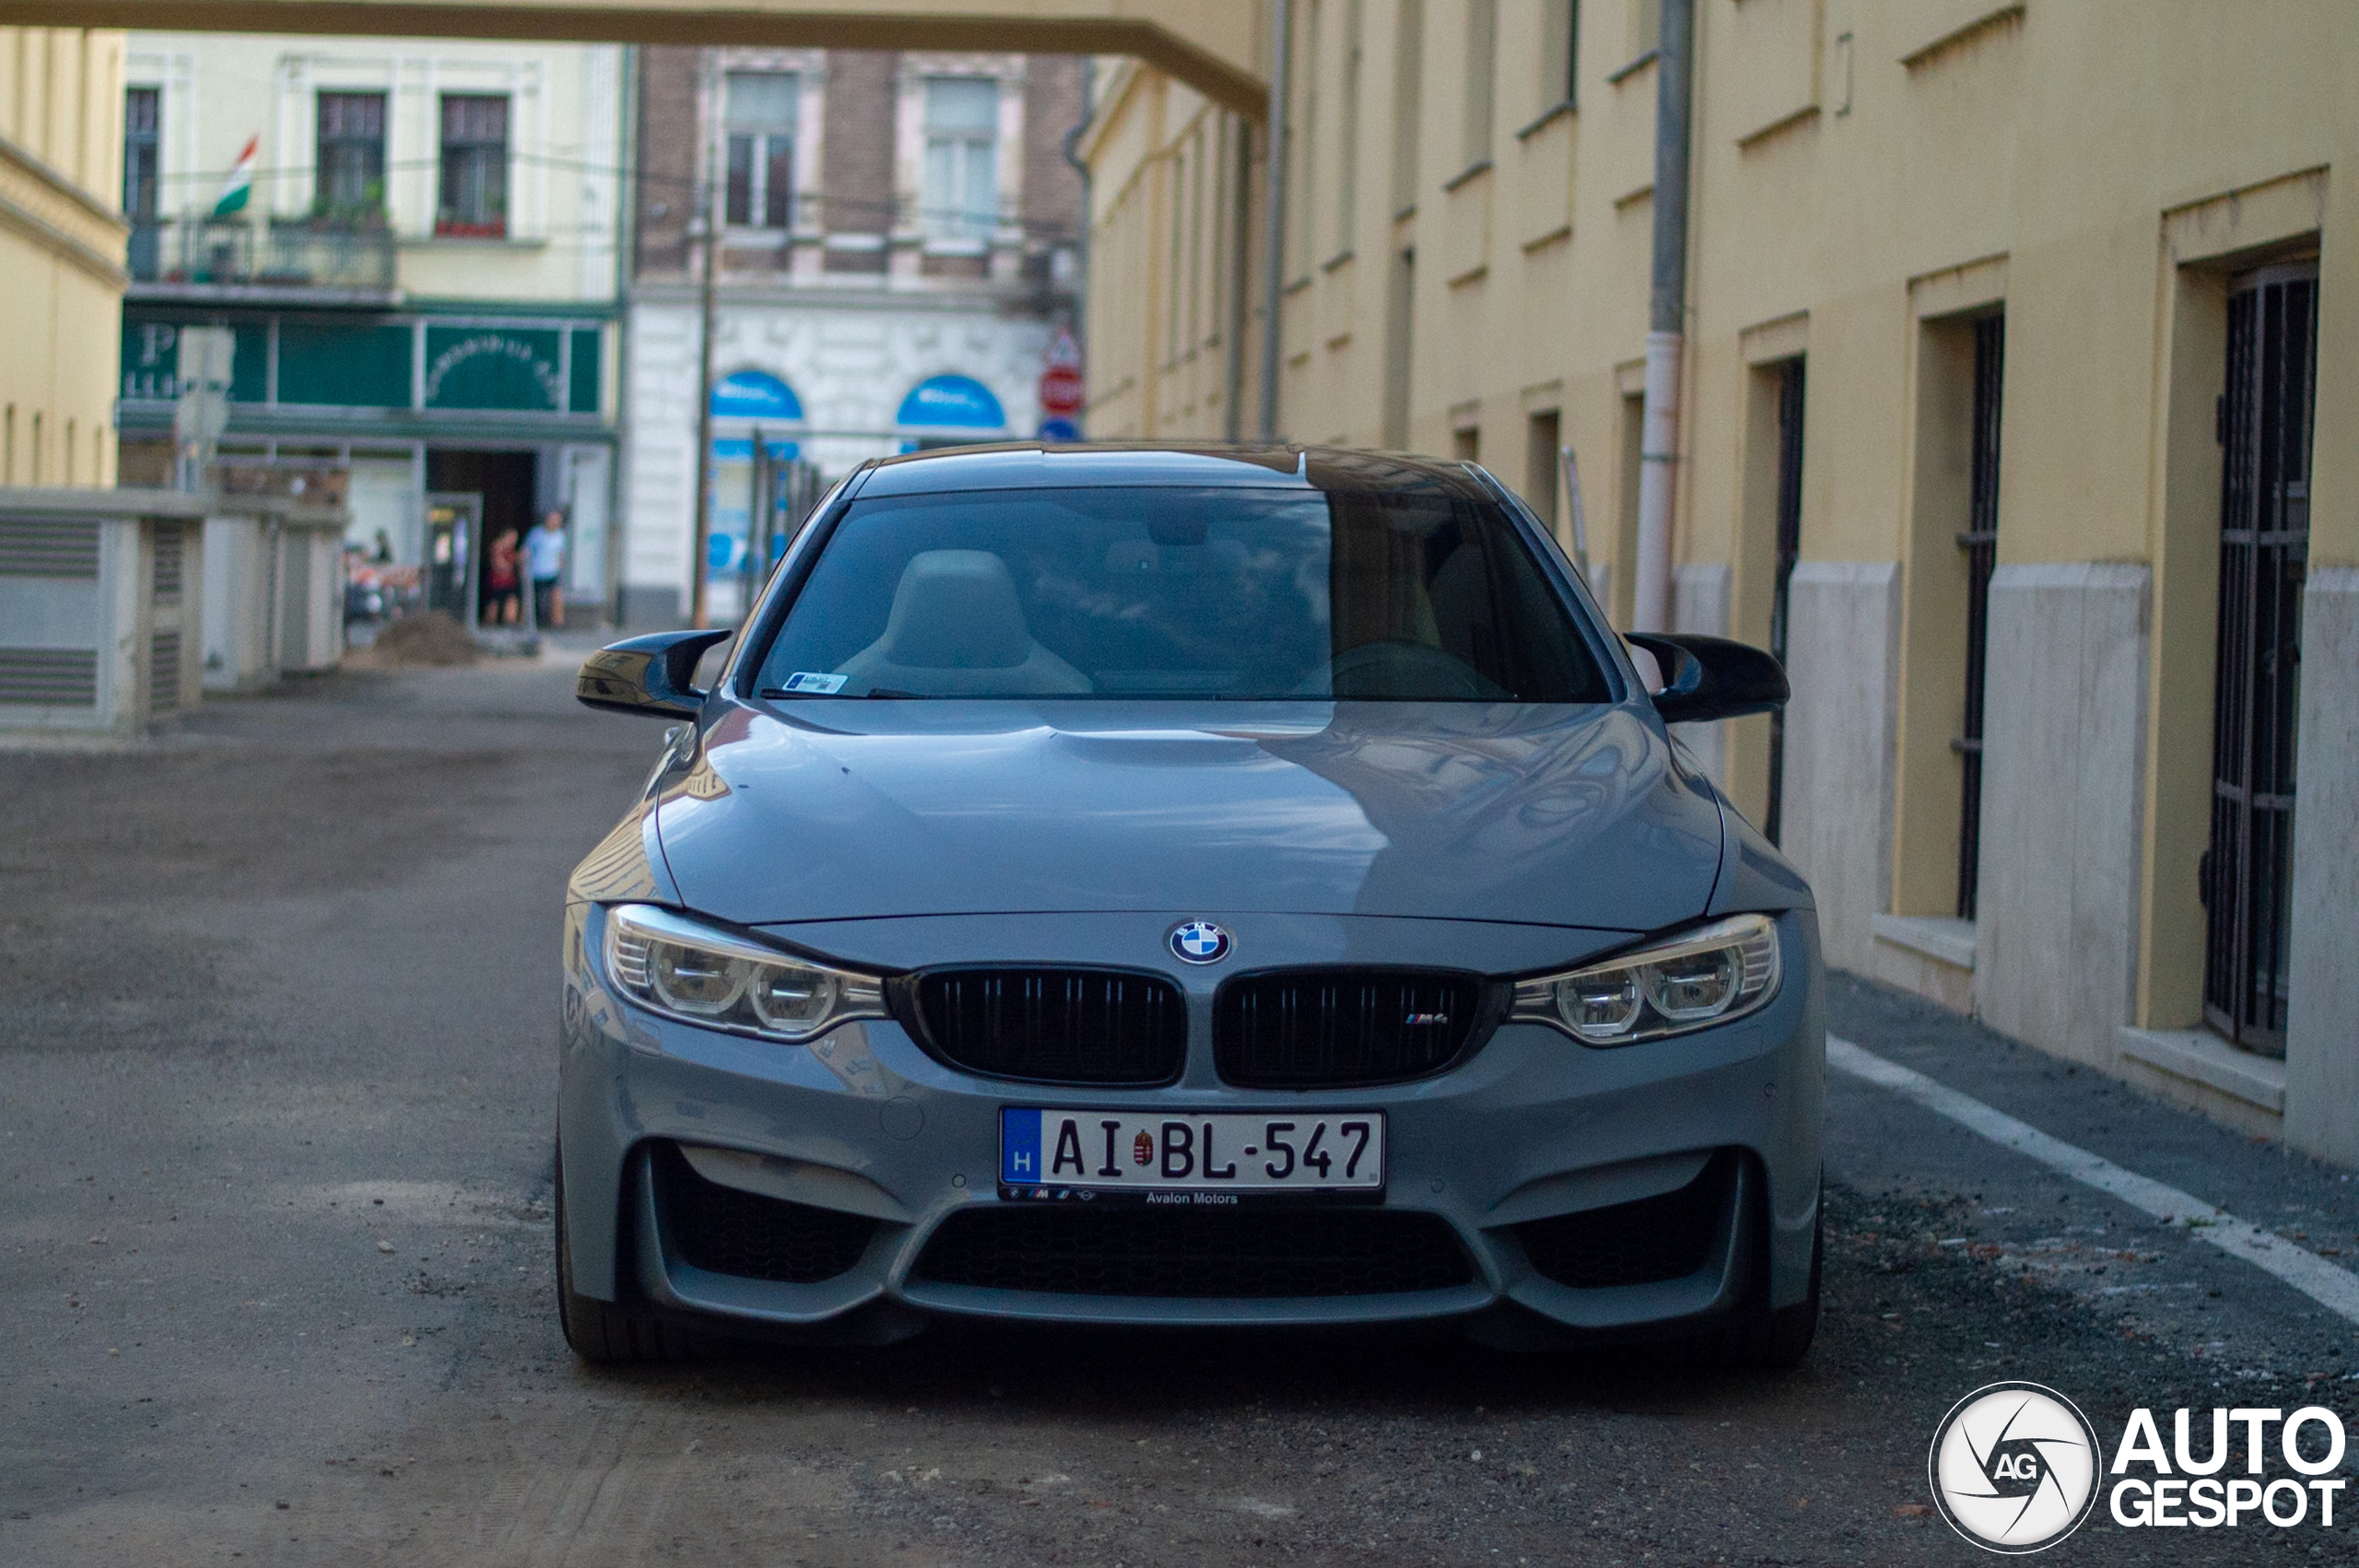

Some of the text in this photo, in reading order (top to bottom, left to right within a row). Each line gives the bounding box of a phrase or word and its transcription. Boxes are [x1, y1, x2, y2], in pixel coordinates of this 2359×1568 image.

[1052, 1119, 1371, 1179] AI BL-547
[1015, 1152, 1030, 1172] H
[1146, 1191, 1238, 1204] Avalon Motors
